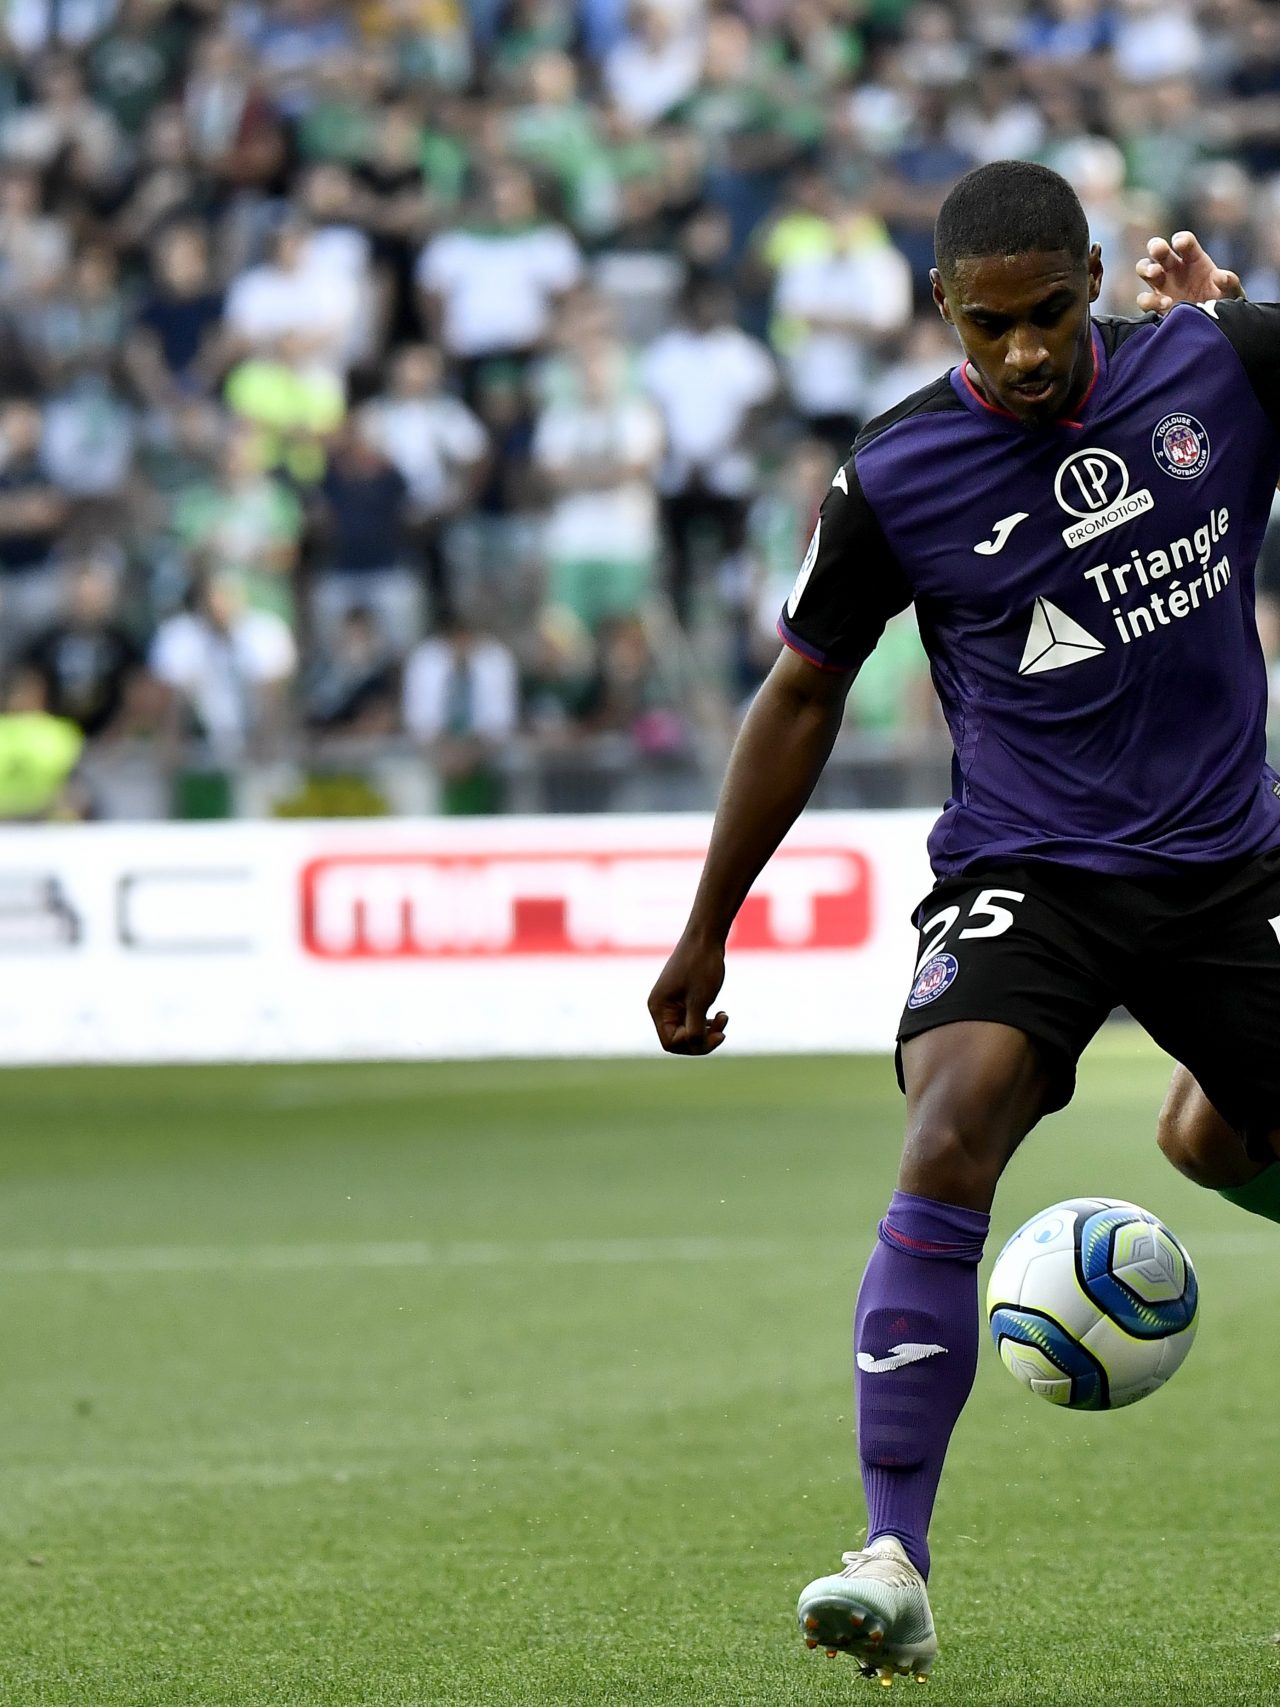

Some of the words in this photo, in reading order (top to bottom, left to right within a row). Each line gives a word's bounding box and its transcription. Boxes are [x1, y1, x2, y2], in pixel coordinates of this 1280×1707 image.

[1157, 416, 1192, 438] TOULOUSE
[1069, 457, 1109, 510] LP
[1167, 464, 1200, 476] FOOTBALL
[1197, 449, 1208, 468] CLUB
[1067, 494, 1150, 544] PROMOTION
[1083, 506, 1230, 604] Triangle
[1112, 554, 1232, 645] intérim
[915, 888, 1026, 980] 25
